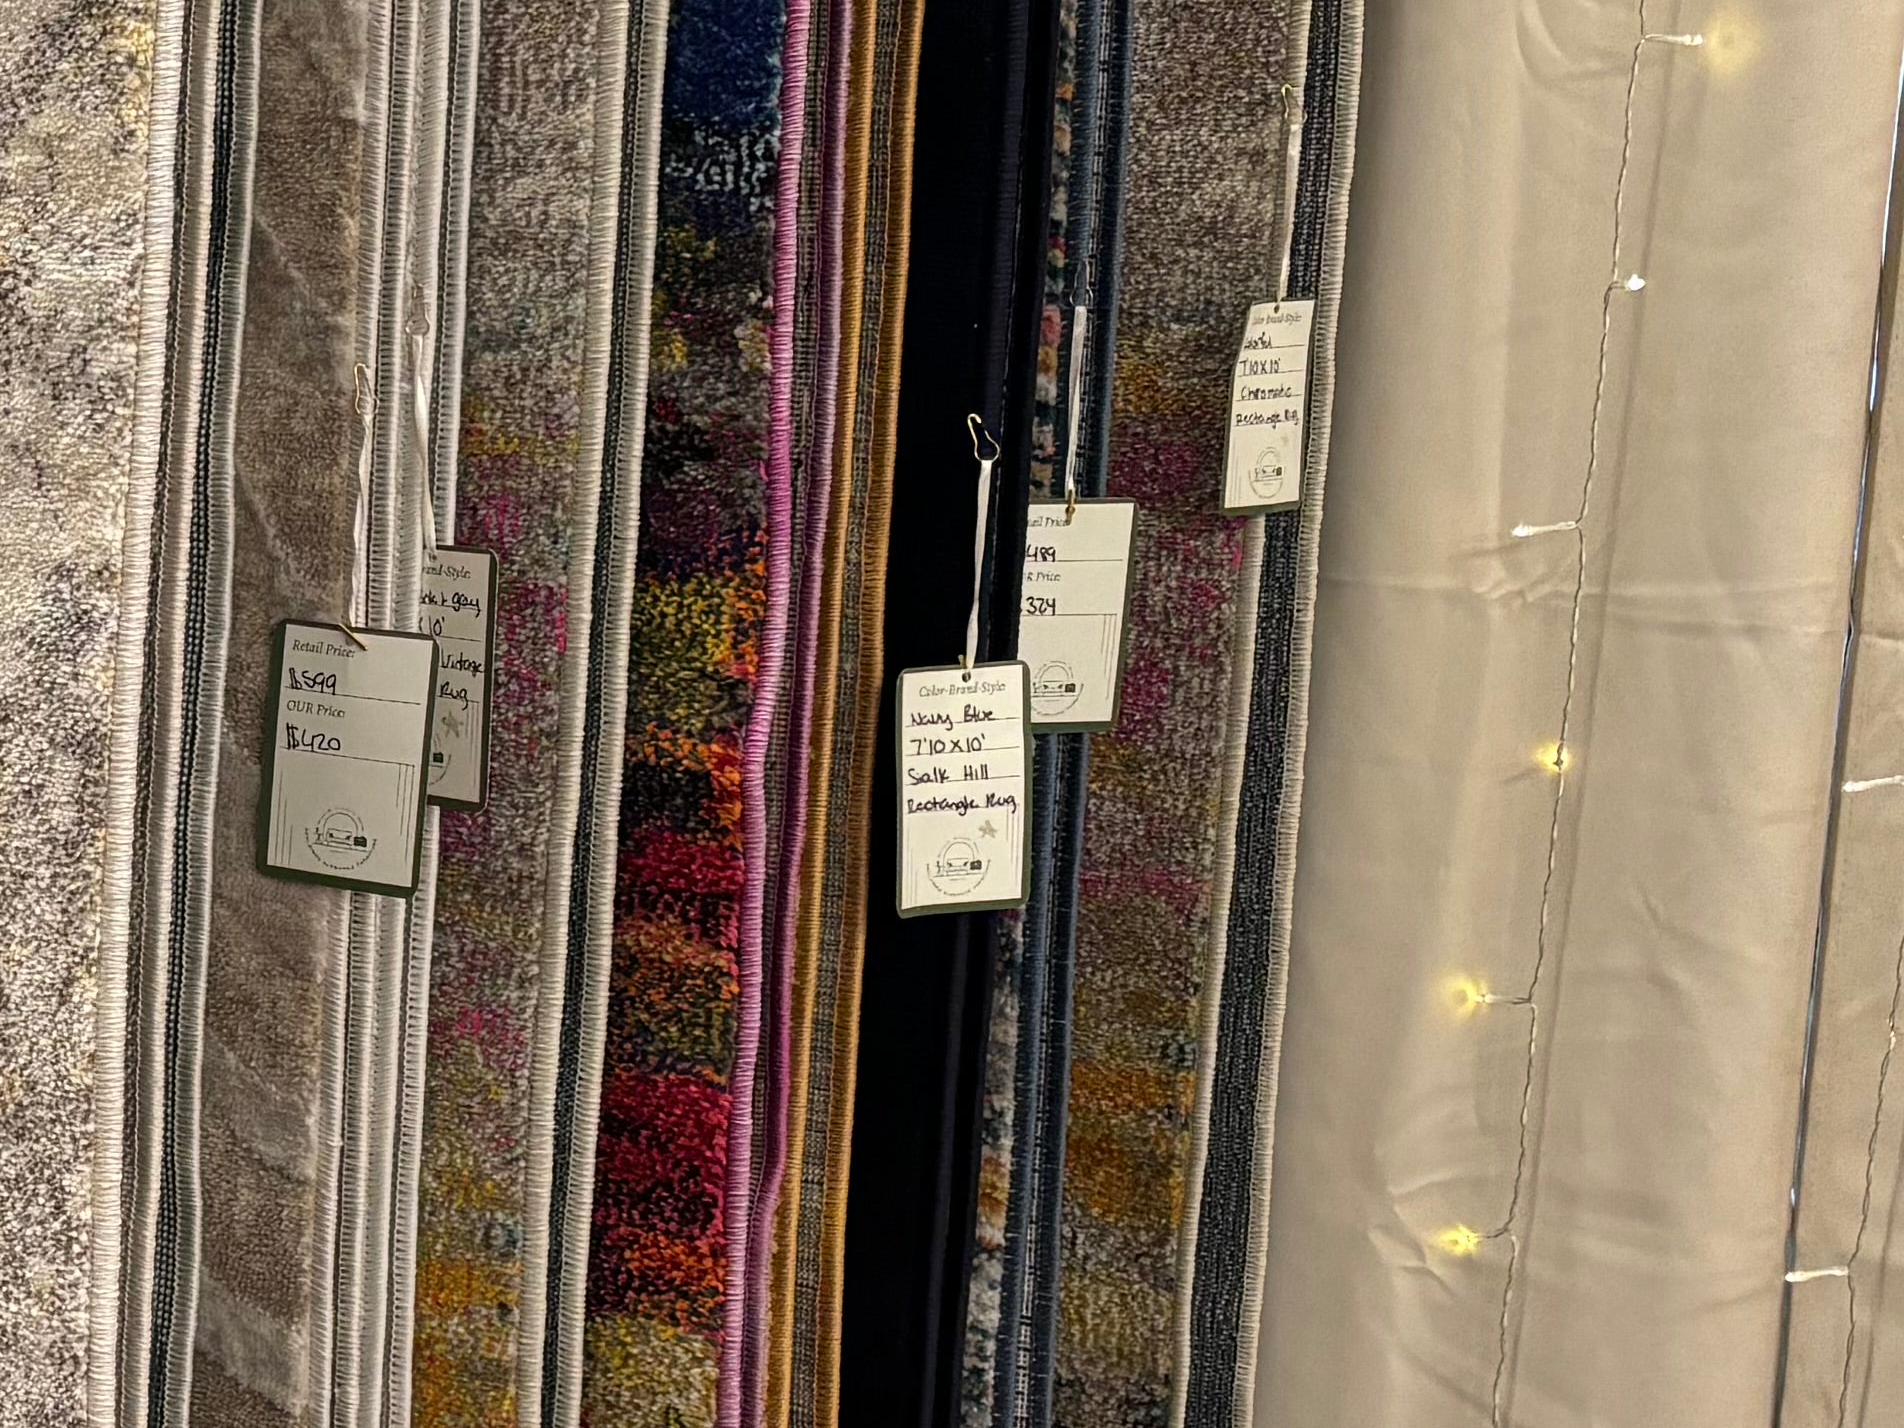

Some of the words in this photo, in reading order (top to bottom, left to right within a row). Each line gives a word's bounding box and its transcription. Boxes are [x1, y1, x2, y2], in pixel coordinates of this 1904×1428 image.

[1025, 596, 1056, 616] 324
[292, 639, 323, 655] Retail
[326, 643, 356, 658] Price:
[289, 667, 337, 695] $599
[286, 699, 313, 715] OUR
[964, 703, 994, 723] Blue
[286, 722, 341, 752] $420
